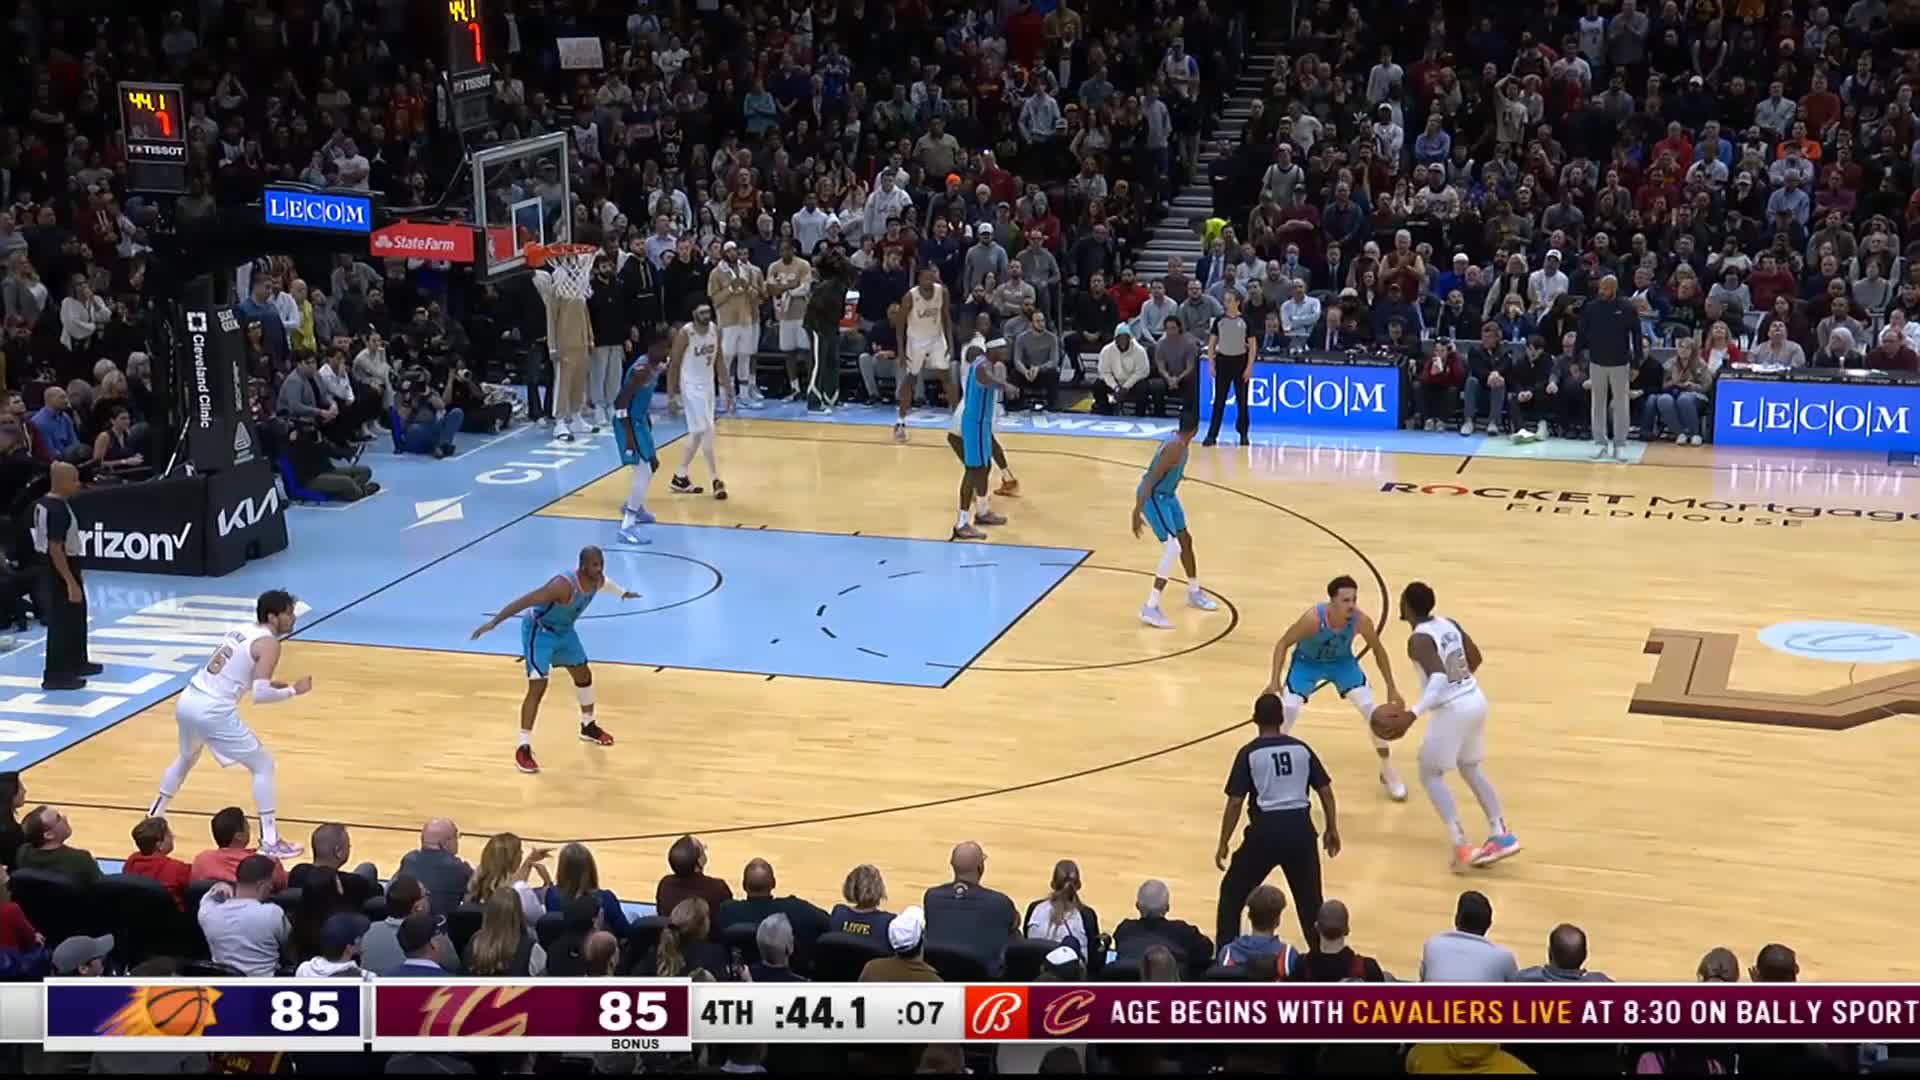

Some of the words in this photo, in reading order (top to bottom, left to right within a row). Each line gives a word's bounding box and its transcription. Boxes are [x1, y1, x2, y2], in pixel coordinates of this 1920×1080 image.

[128, 92, 166, 111] 44.1
[155, 111, 171, 137] 7
[192, 334, 210, 393] Cleveland
[199, 394, 213, 430] Clinic
[1381, 482, 1636, 505] ROCKET
[1650, 496, 1920, 523] Mortgag
[1507, 503, 1803, 528] FIELDHOUSE
[79, 521, 175, 561] rizon
[1271, 751, 1293, 777] 19
